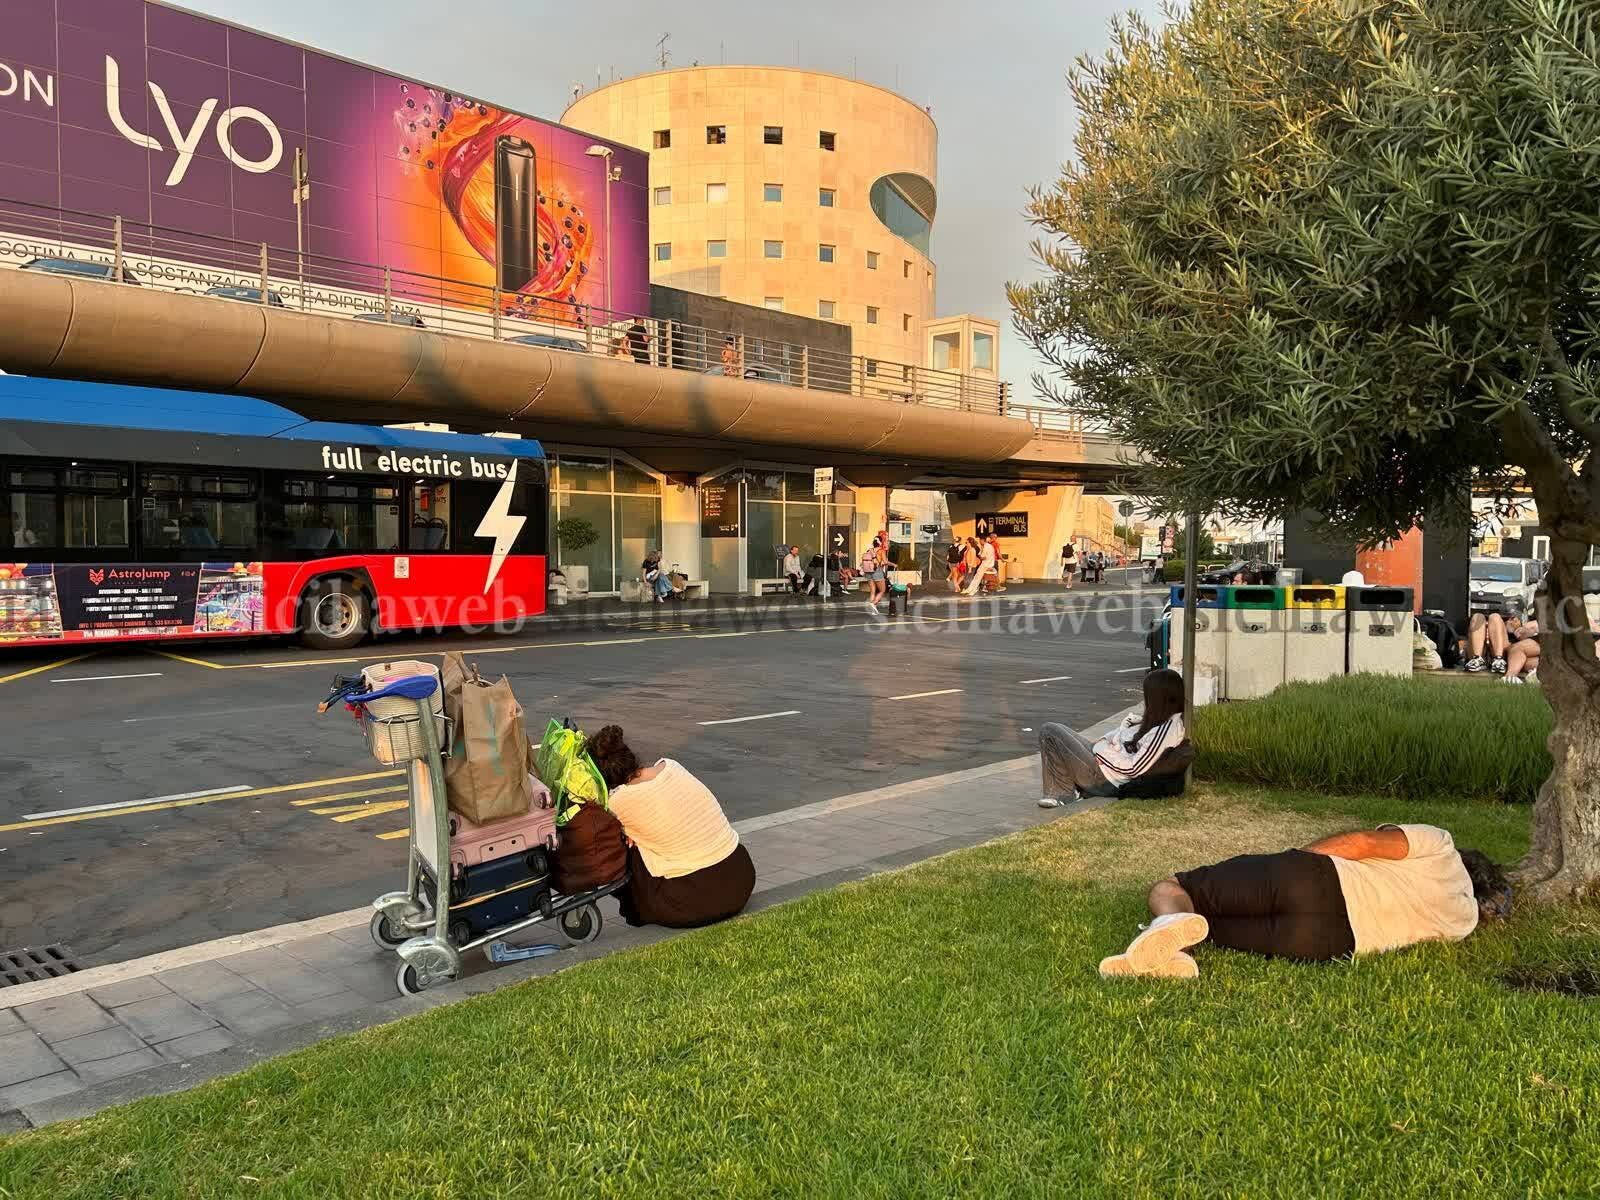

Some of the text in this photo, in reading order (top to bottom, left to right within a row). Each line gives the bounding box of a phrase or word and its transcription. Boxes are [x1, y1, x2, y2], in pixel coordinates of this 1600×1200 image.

[321, 445, 508, 479] full electric bus
[995, 516, 1026, 526] TERMINAL
[1013, 524, 1027, 533] BUS
